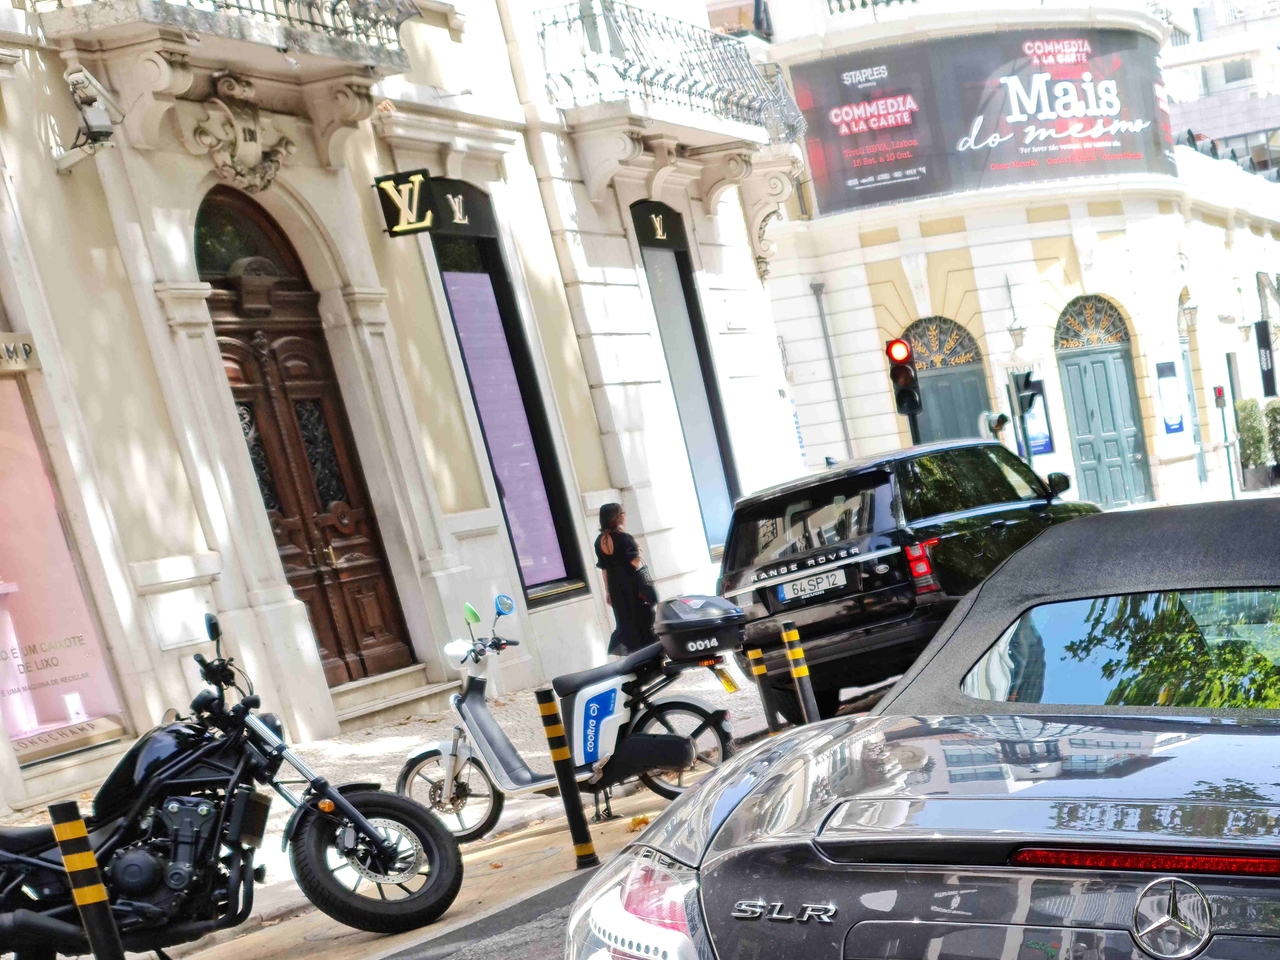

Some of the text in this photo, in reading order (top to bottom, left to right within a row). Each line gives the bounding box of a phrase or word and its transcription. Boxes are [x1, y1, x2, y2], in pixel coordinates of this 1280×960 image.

[1024, 39, 1091, 54] COMMEDIA
[1042, 54, 1055, 64] LA
[1056, 53, 1087, 64] CARTE
[842, 65, 888, 84] STAPLES
[1000, 72, 1121, 123] Mais
[830, 95, 917, 123] COMMEDIA
[851, 119, 867, 132] LA
[870, 112, 911, 128] CARTE
[957, 115, 1014, 152] do
[1020, 119, 1151, 144] mesmo
[843, 147, 865, 158] Tivoli
[891, 139, 918, 149] Lisboa
[750, 547, 860, 582] RANGE ROVER
[21, 644, 38, 656] UM
[687, 638, 718, 652] 0014
[17, 657, 59, 675] DE LIXO
[587, 719, 596, 753] cooltra
[731, 899, 838, 923] SLR
